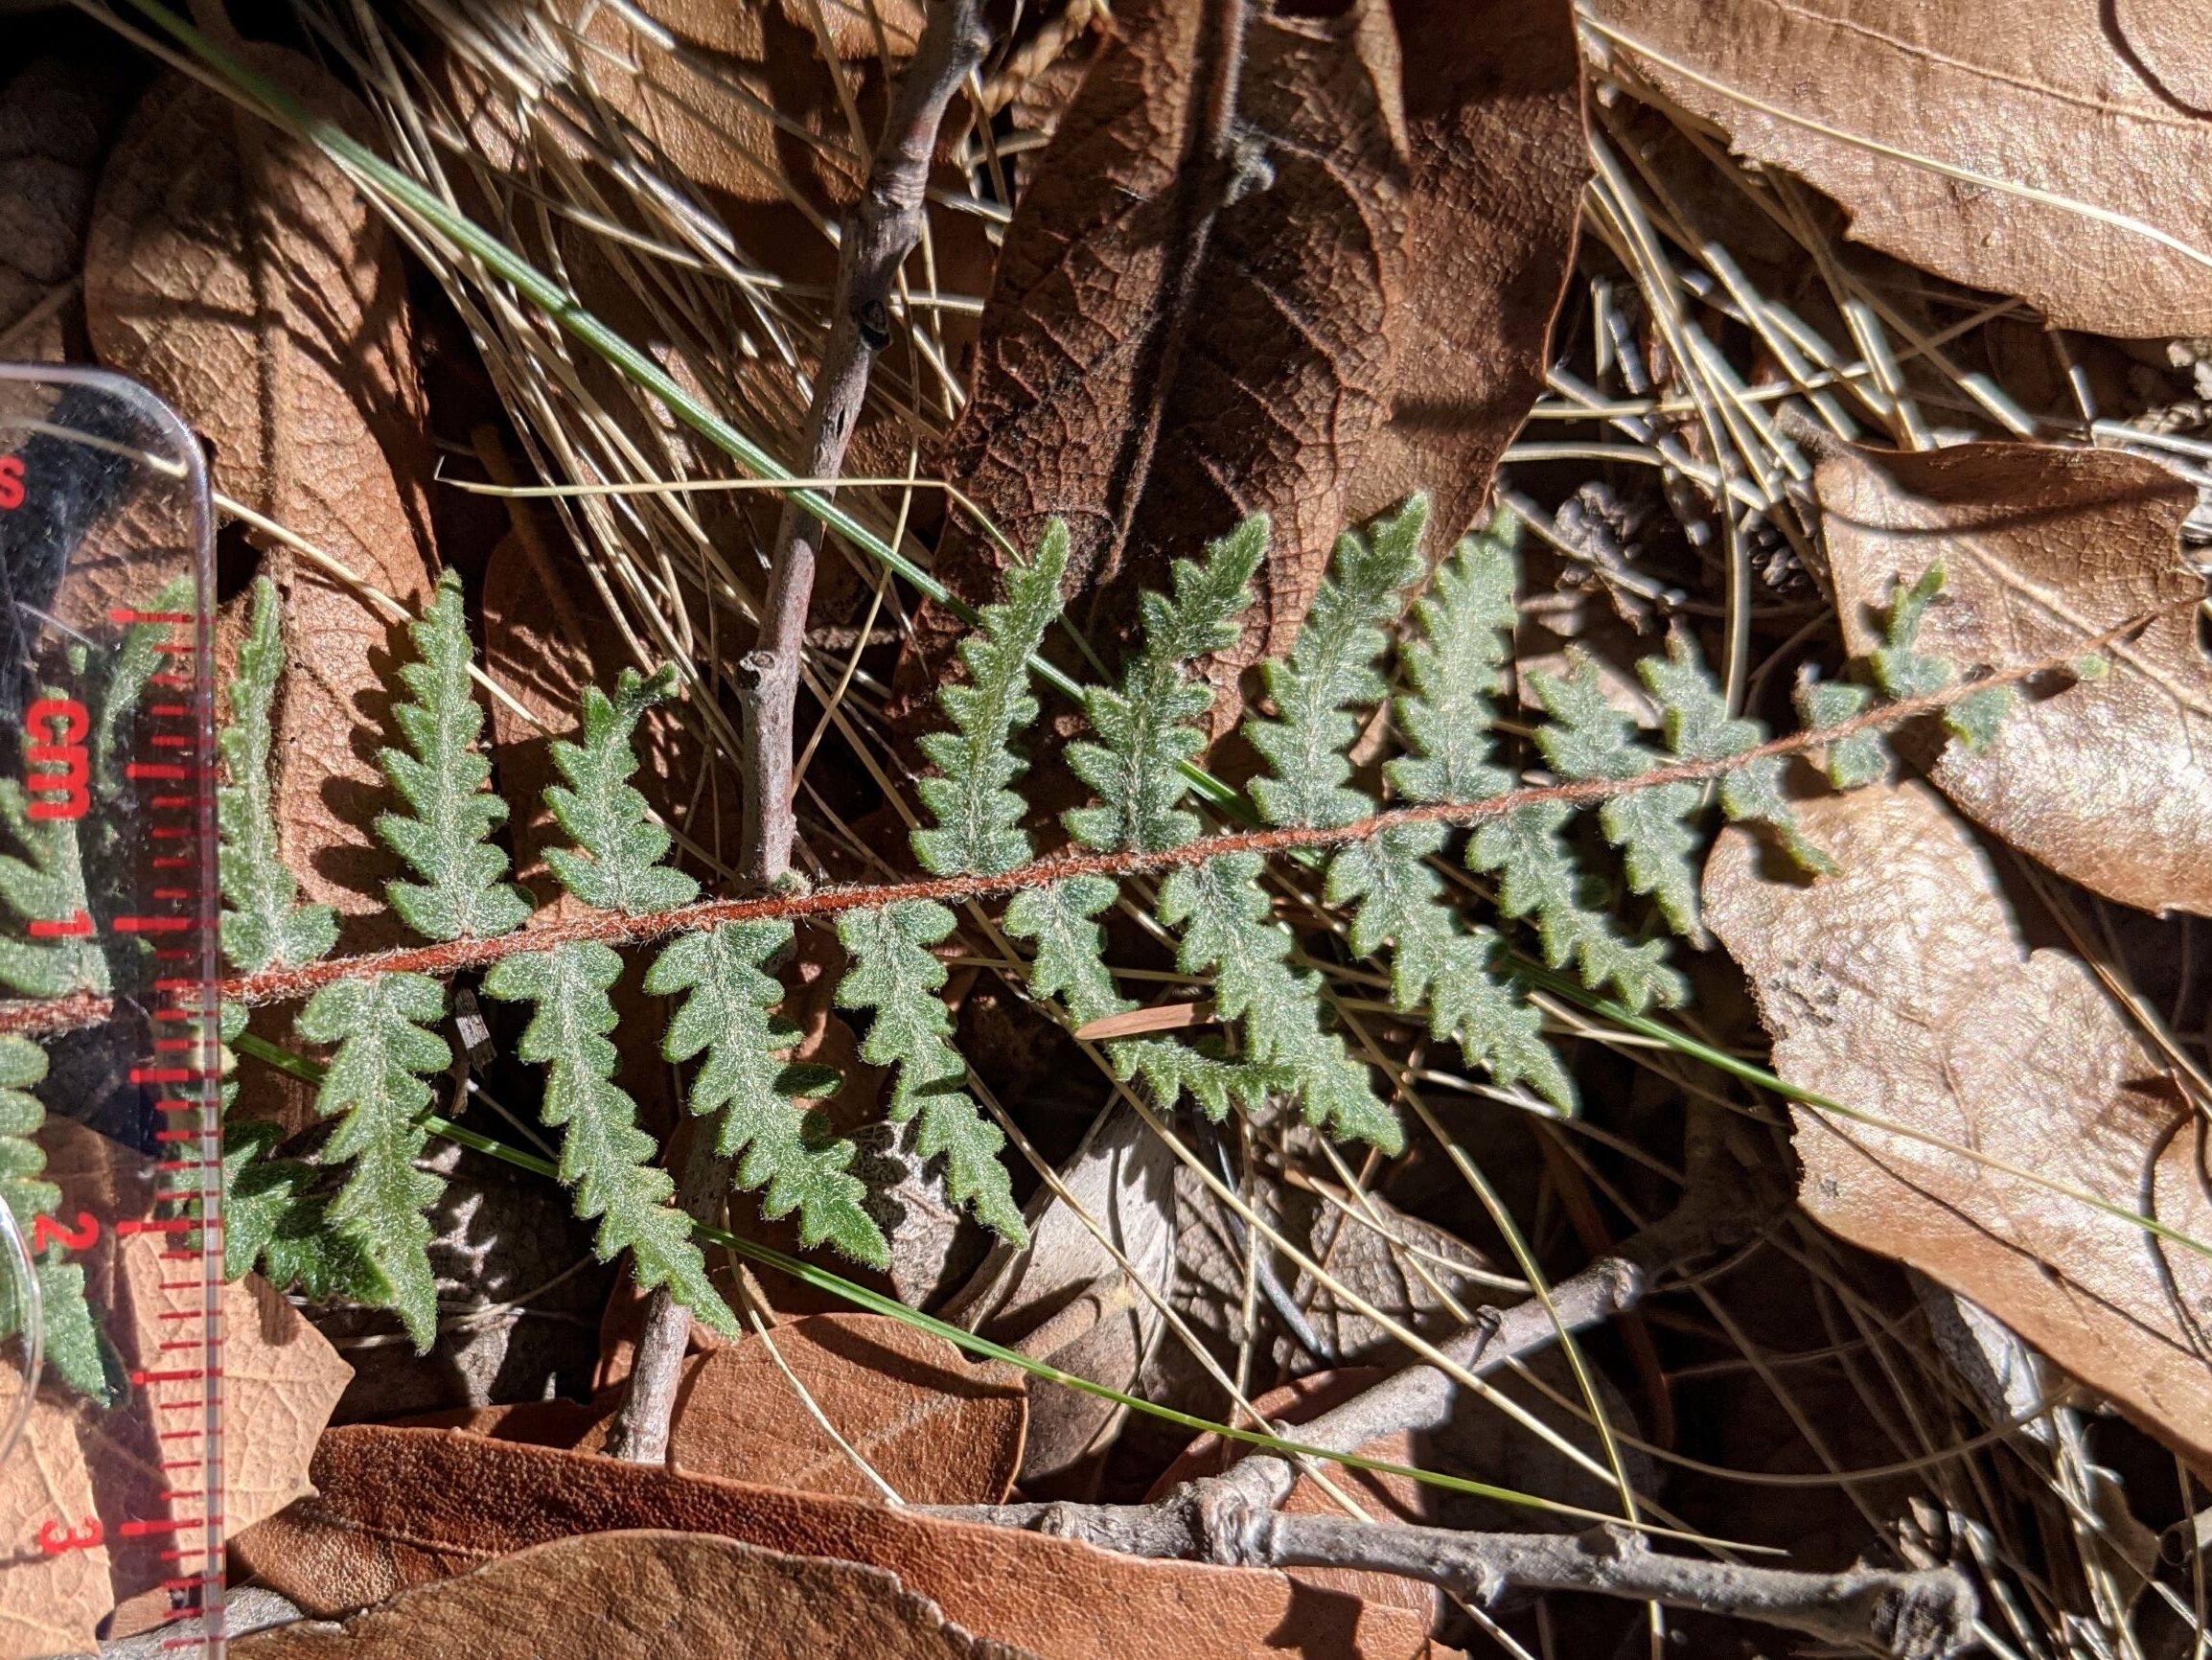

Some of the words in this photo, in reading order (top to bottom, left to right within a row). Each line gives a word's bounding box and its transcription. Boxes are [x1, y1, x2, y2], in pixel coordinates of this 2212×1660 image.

[26, 700, 90, 819] cm
[28, 910, 94, 936] 1
[34, 1211, 101, 1251] 2
[37, 1516, 104, 1556] 3
